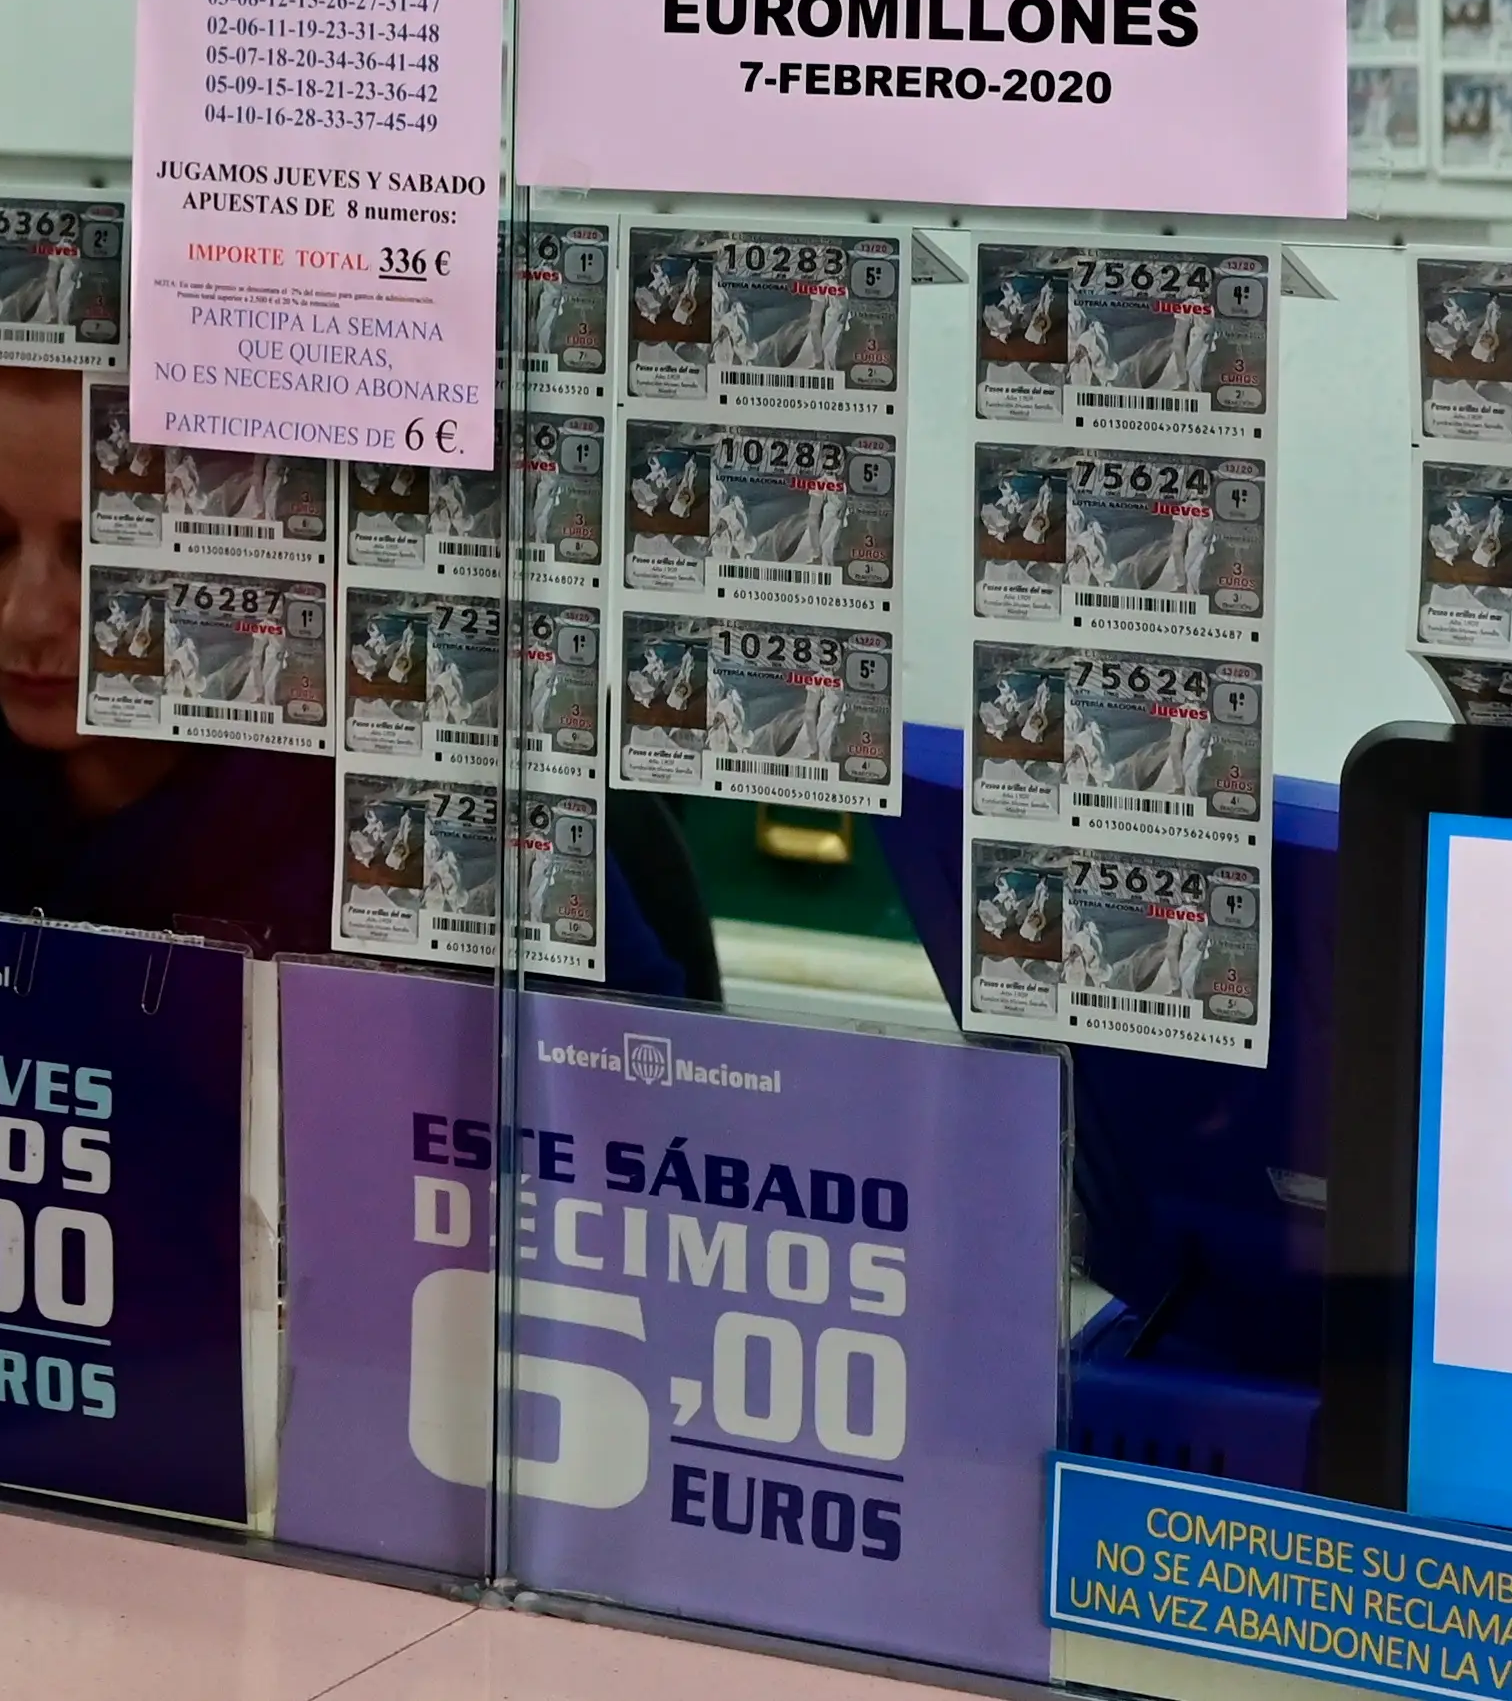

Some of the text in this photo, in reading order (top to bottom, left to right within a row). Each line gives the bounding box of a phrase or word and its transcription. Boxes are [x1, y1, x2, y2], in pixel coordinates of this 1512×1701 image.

[207, 16, 440, 43] 02-06-11-19-23-31-34-48
[206, 45, 439, 73] 05-07-18-20-34-36-41-48
[206, 75, 438, 102] 05-09-15-18-21-23-36-42
[739, 61, 1112, 104] 7-FEBRERO-2020
[205, 104, 437, 132] 04-10-16-28-33-37-45-49
[156, 160, 486, 196] JUGAMOS JUEVES Y SABADO
[183, 191, 457, 225] APUESTAS DE 8 numeros:
[188, 243, 284, 267] IMPORTE
[379, 246, 427, 276] 336
[435, 250, 451, 276] €
[724, 244, 844, 275] 10283
[1076, 261, 1210, 292] 75624
[191, 306, 444, 342] PARTICIPA LA SEMANA
[1152, 300, 1213, 315] Jueves
[238, 339, 393, 369] QUE QUIERAS,
[155, 362, 480, 405] NO ES NECESARIO ABONARSE
[165, 412, 358, 446] PARTICIPACIONES
[366, 428, 395, 449] DE
[404, 417, 424, 451] 6
[173, 583, 283, 614] 76287
[538, 1040, 781, 1095] Lotería Nacional
[605, 1136, 909, 1234] SÁBADO
[408, 1267, 908, 1510] 6,00
[670, 1462, 903, 1562] EUROS
[1146, 1508, 1354, 1574] COMPRUEBE
[1363, 1547, 1407, 1582] SU
[1096, 1539, 1145, 1575] NO
[1153, 1550, 1189, 1582] SE
[1196, 1558, 1354, 1615] ADMITEN
[1070, 1575, 1141, 1619] UNA
[1146, 1591, 1209, 1632] VEZ
[1213, 1606, 1430, 1673] ABANDONEN
[1440, 1645, 1479, 1683] LA
